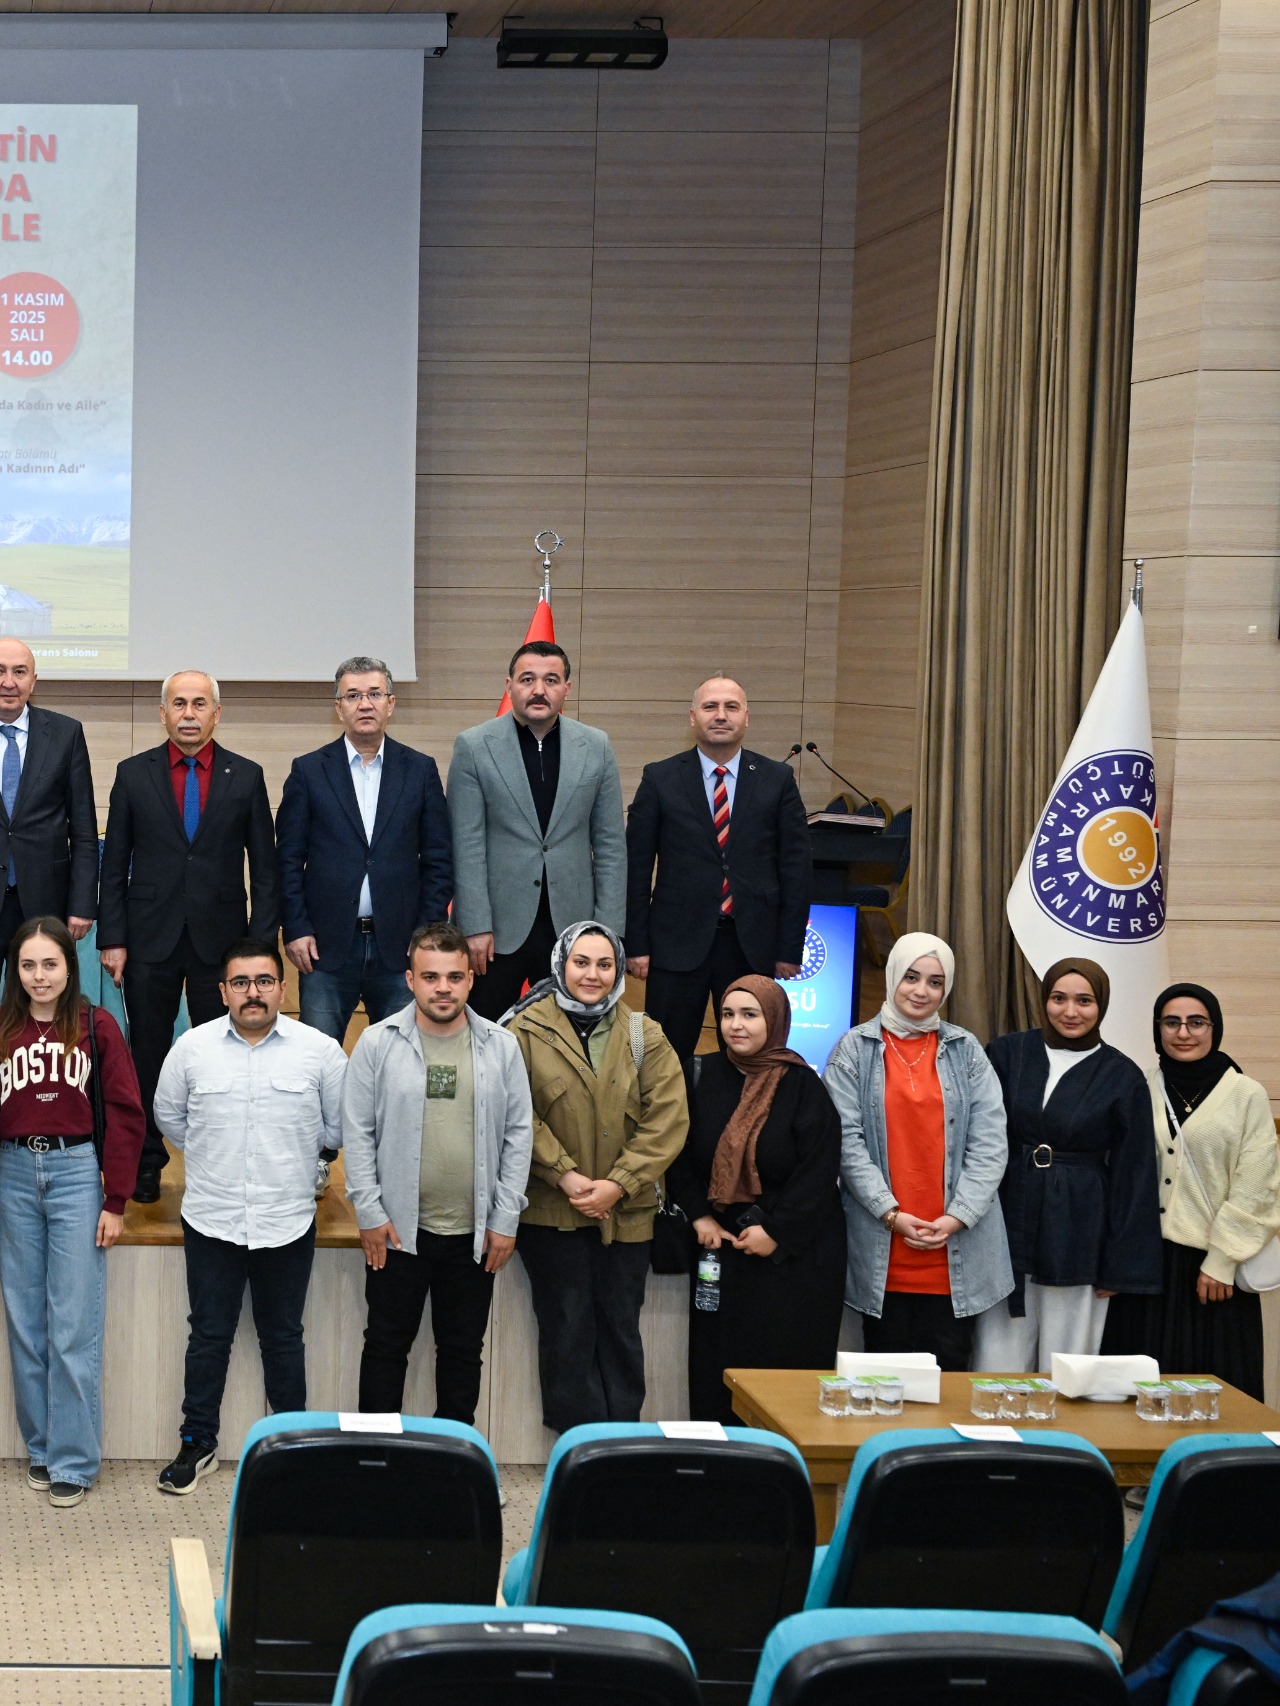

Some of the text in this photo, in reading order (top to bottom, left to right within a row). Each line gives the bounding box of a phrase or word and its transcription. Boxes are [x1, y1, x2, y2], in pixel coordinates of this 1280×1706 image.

[14, 292, 64, 306] KASIM
[9, 311, 46, 324] 2025
[10, 328, 45, 342] SALI
[2, 350, 53, 366] 14.00
[17, 399, 53, 411] Kadın
[57, 402, 71, 411] ve
[7, 463, 55, 474] Kadının
[31, 648, 60, 657] erans
[63, 648, 98, 657] Salonu
[1068, 760, 1154, 794] SÜTÇÜ
[1056, 784, 1162, 910] KAHRAMANMAR
[1098, 817, 1146, 880] 1992
[1040, 875, 1165, 933] ÜNİVERSİ
[787, 987, 817, 1012] SÜ
[0, 1042, 92, 1106] BOSTON
